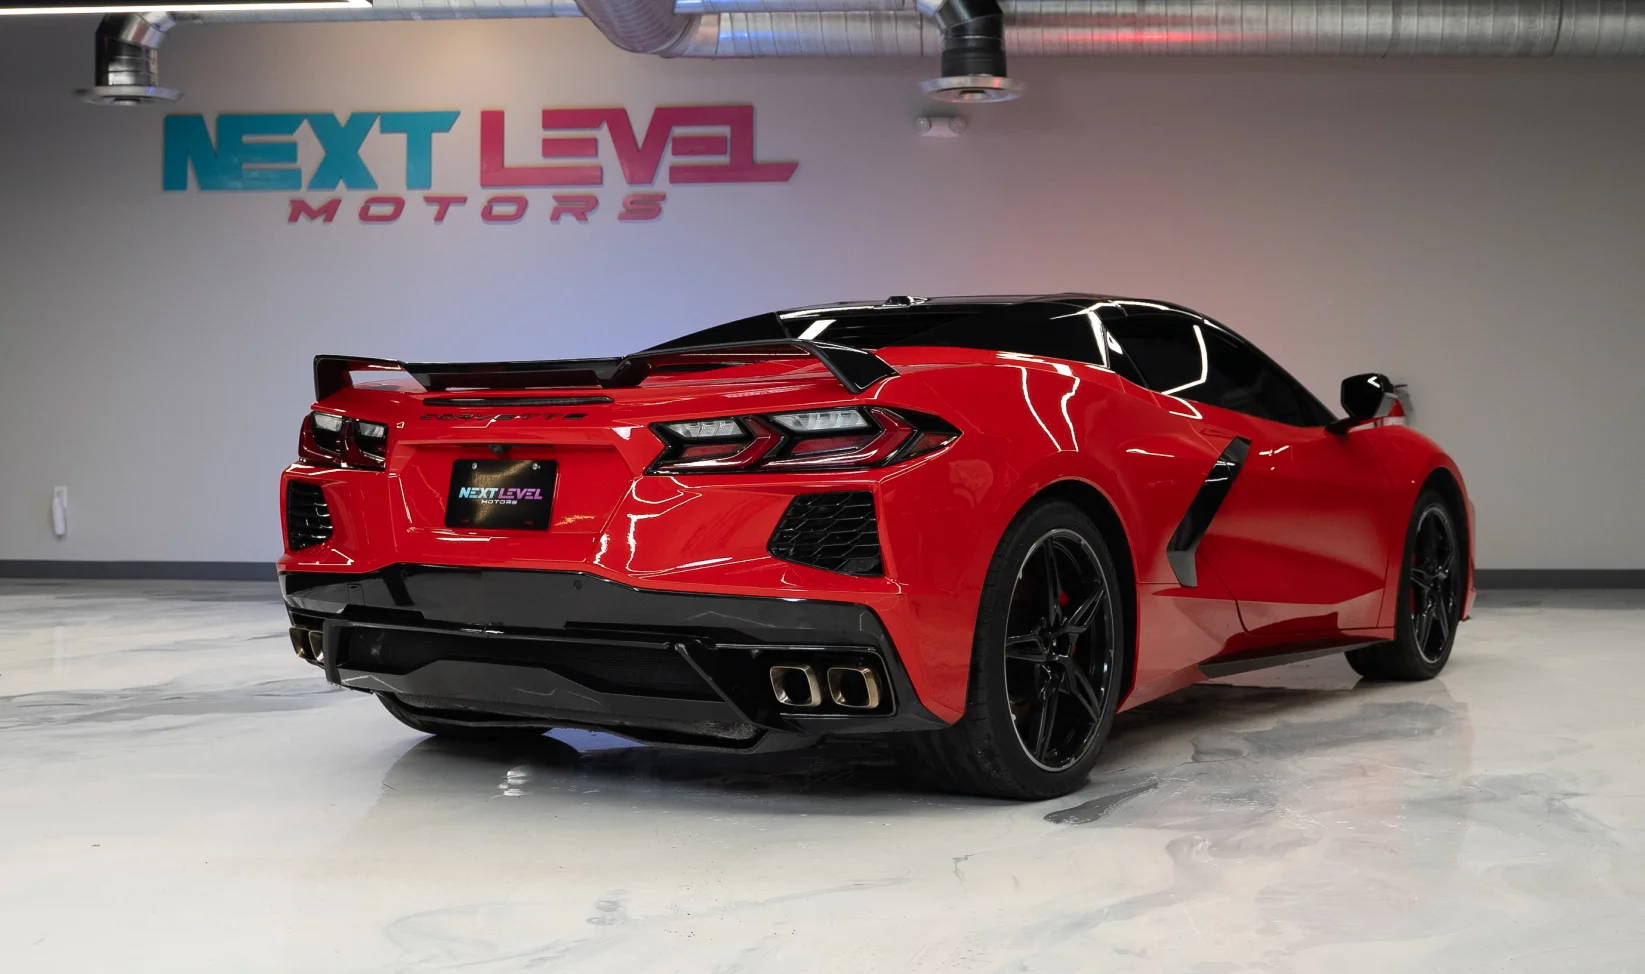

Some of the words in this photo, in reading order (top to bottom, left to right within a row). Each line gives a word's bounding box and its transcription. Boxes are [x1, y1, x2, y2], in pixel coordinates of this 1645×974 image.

[163, 111, 460, 191] NEXT
[480, 105, 800, 188] LEVEL
[287, 194, 667, 224] MOTORS
[420, 413, 588, 421] CORVETTE
[458, 487, 498, 499] NEXT
[498, 487, 543, 500] LEVEL
